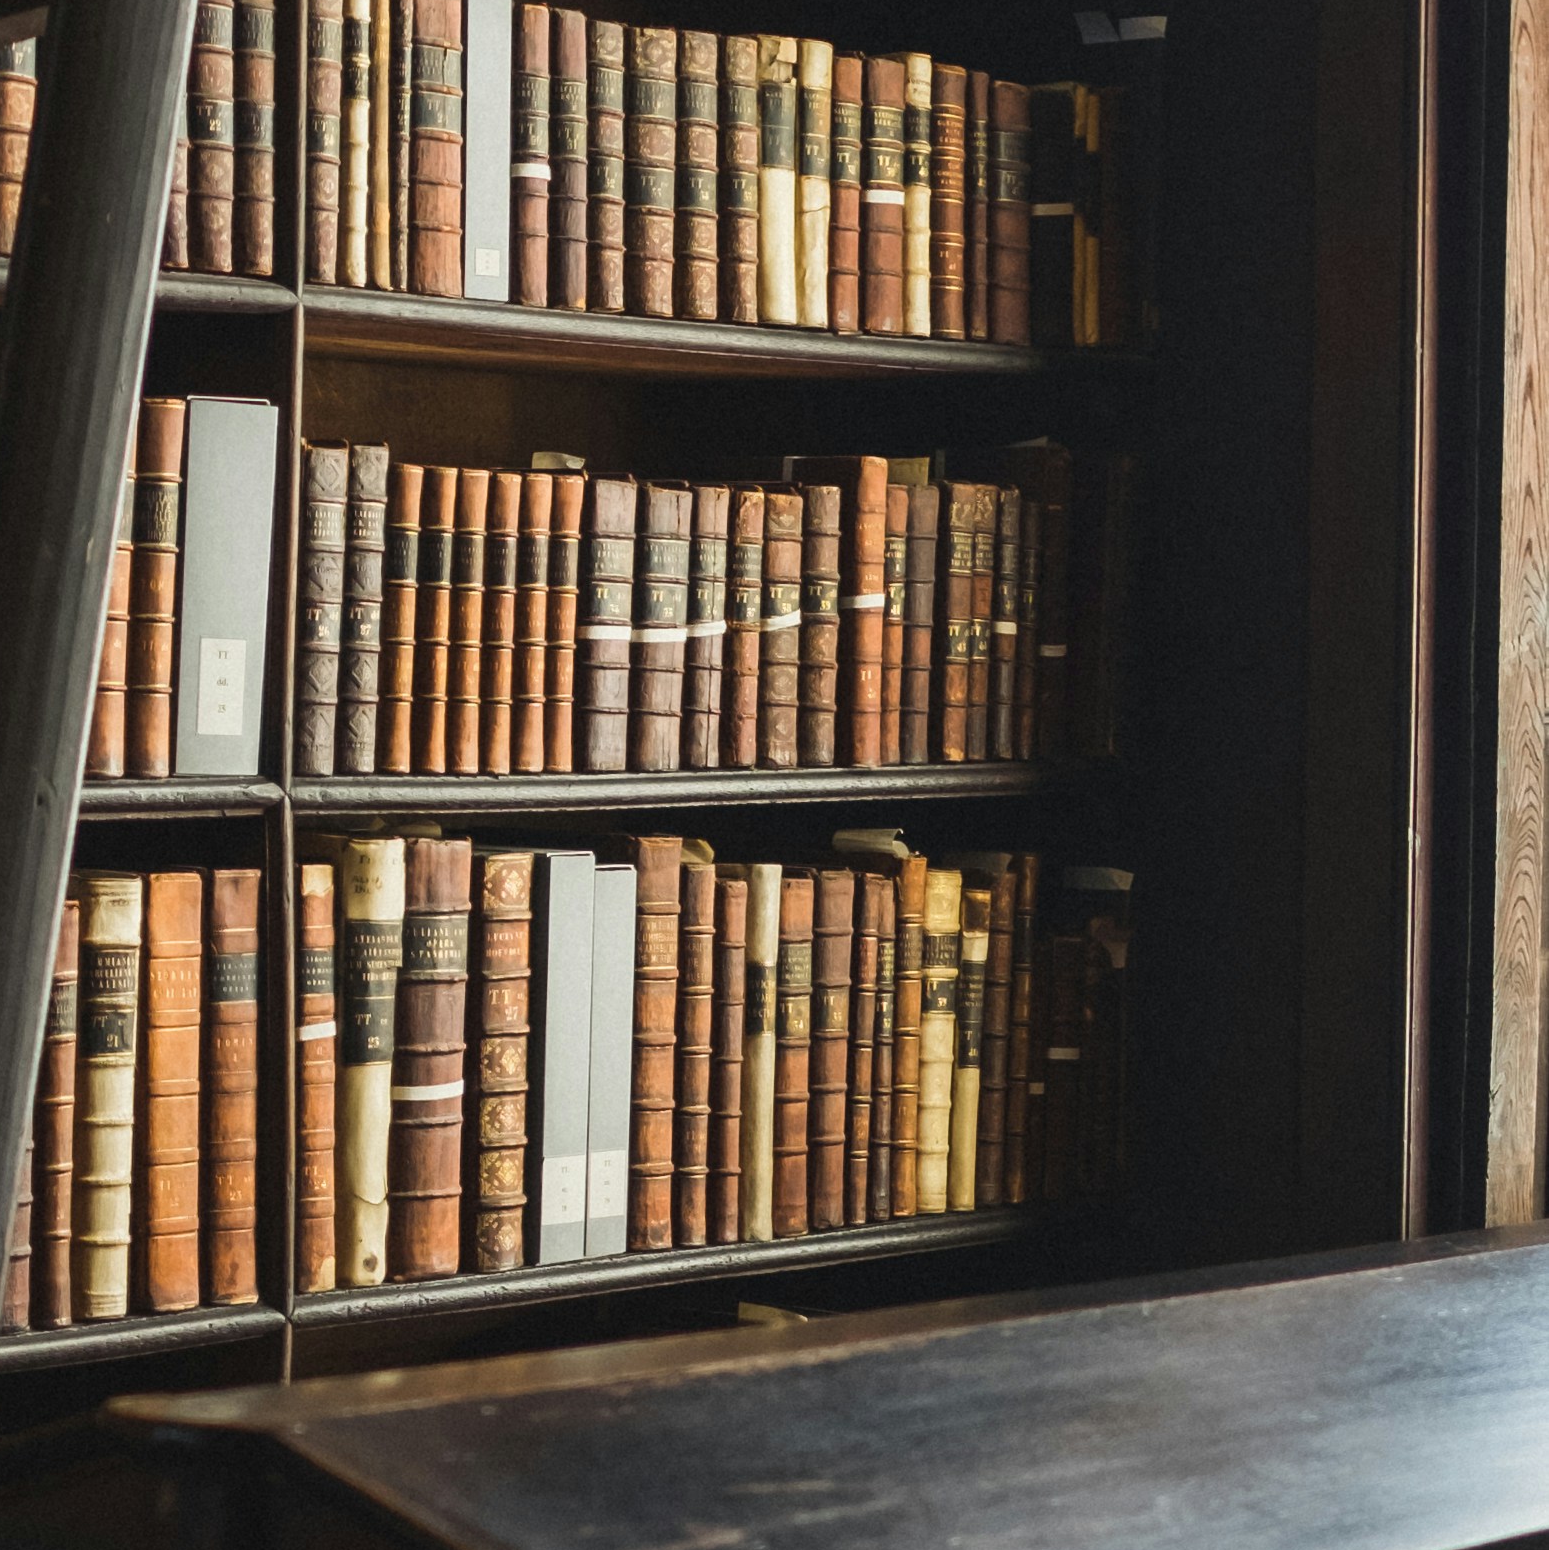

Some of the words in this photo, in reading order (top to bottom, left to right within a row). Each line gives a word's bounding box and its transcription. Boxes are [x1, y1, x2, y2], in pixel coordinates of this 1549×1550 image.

[489, 988, 511, 1006] TT
[354, 1013, 372, 1027] TT
[505, 1006, 519, 1021] 27
